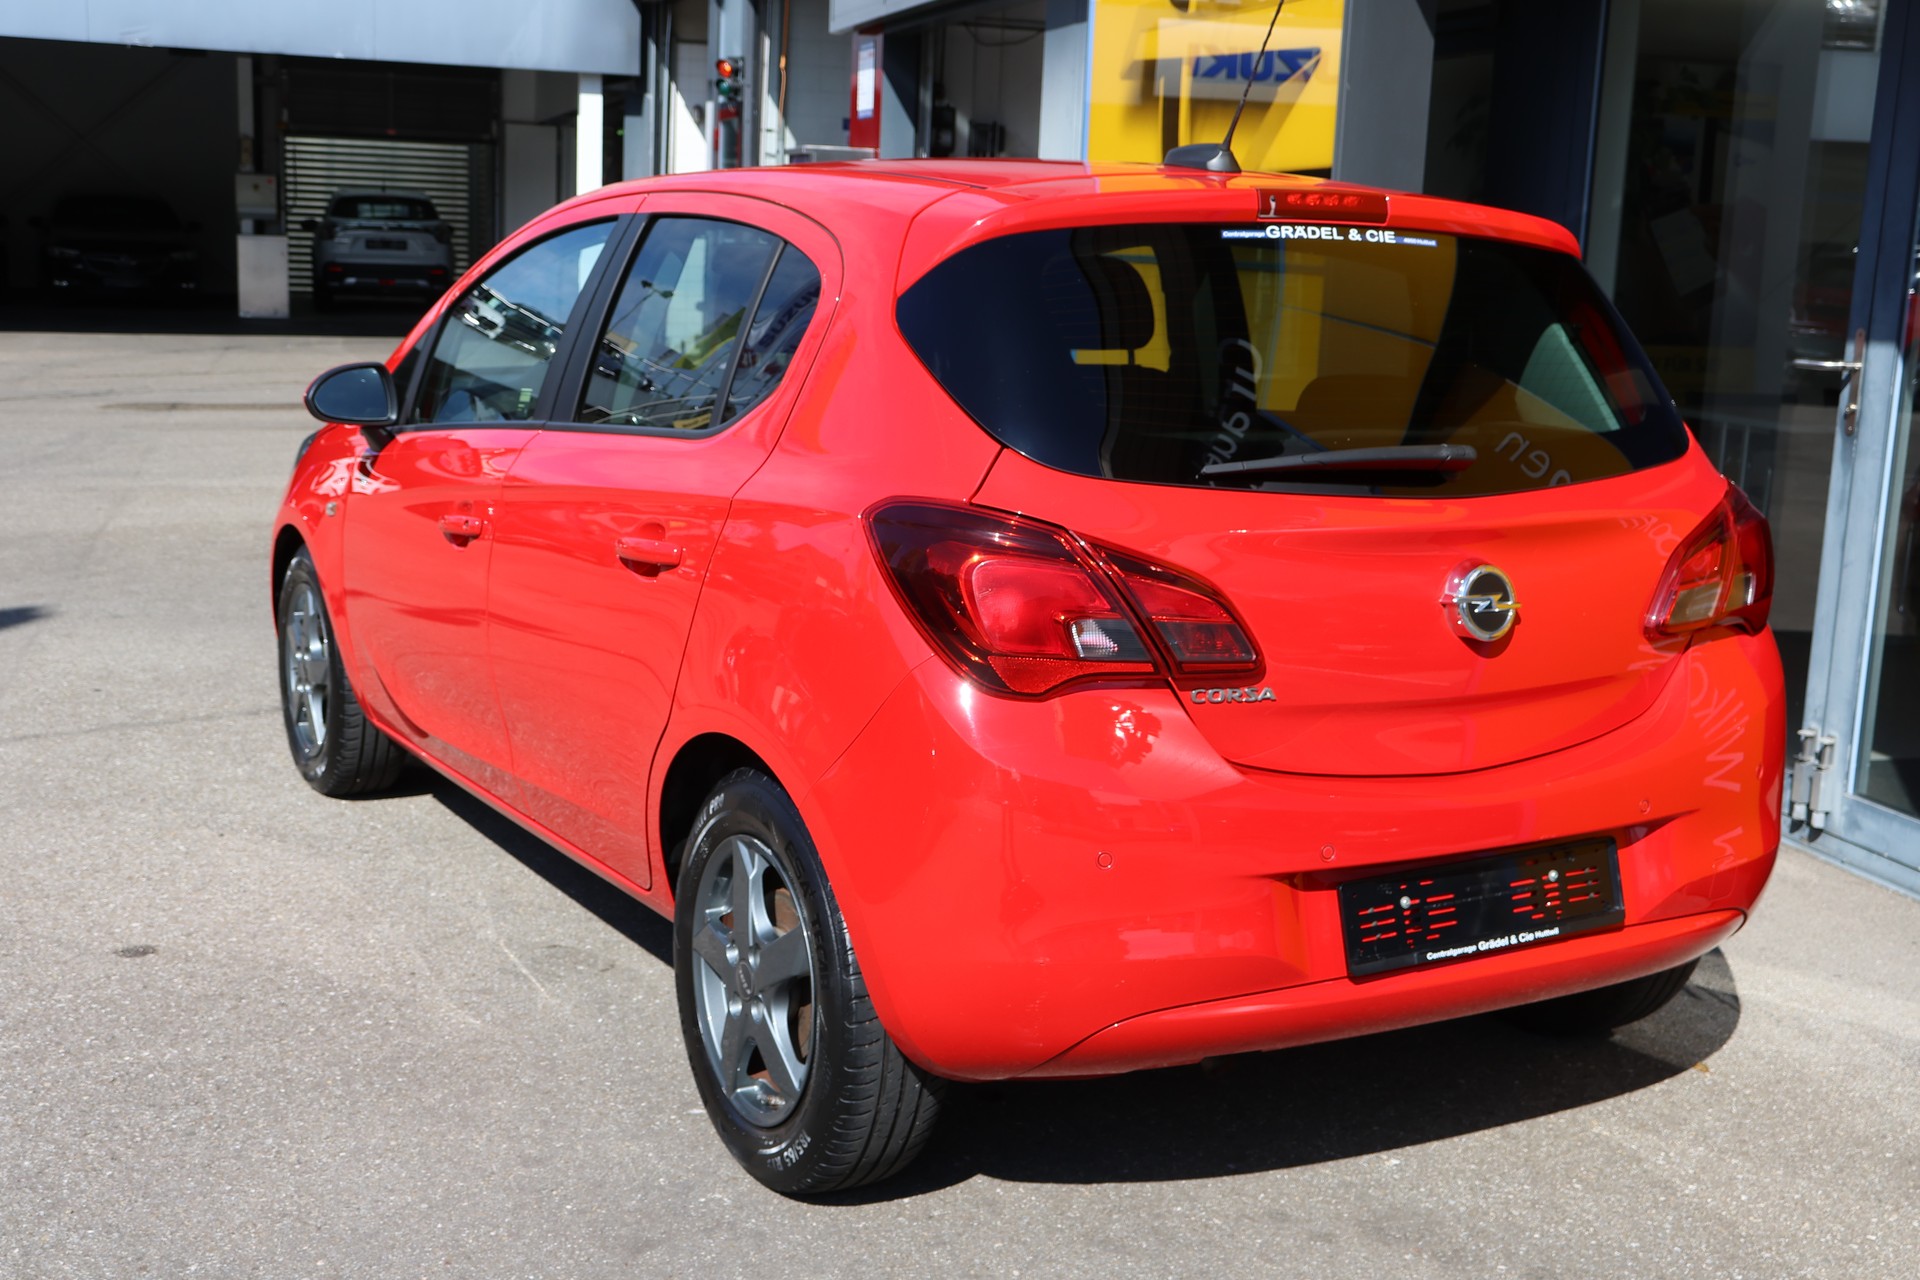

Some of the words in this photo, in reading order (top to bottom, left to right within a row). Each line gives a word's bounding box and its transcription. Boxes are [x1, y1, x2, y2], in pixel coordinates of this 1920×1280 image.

[1265, 225, 1344, 241] GRÄDEL
[1348, 228, 1362, 242] &
[1365, 229, 1397, 244] CIE
[1191, 686, 1277, 704] CORSA
[1426, 944, 1477, 960] Centralgarage
[1478, 936, 1509, 951] Grädel
[1510, 934, 1518, 945] &
[1518, 931, 1534, 943] Cie
[1534, 927, 1560, 939] Huttwil
